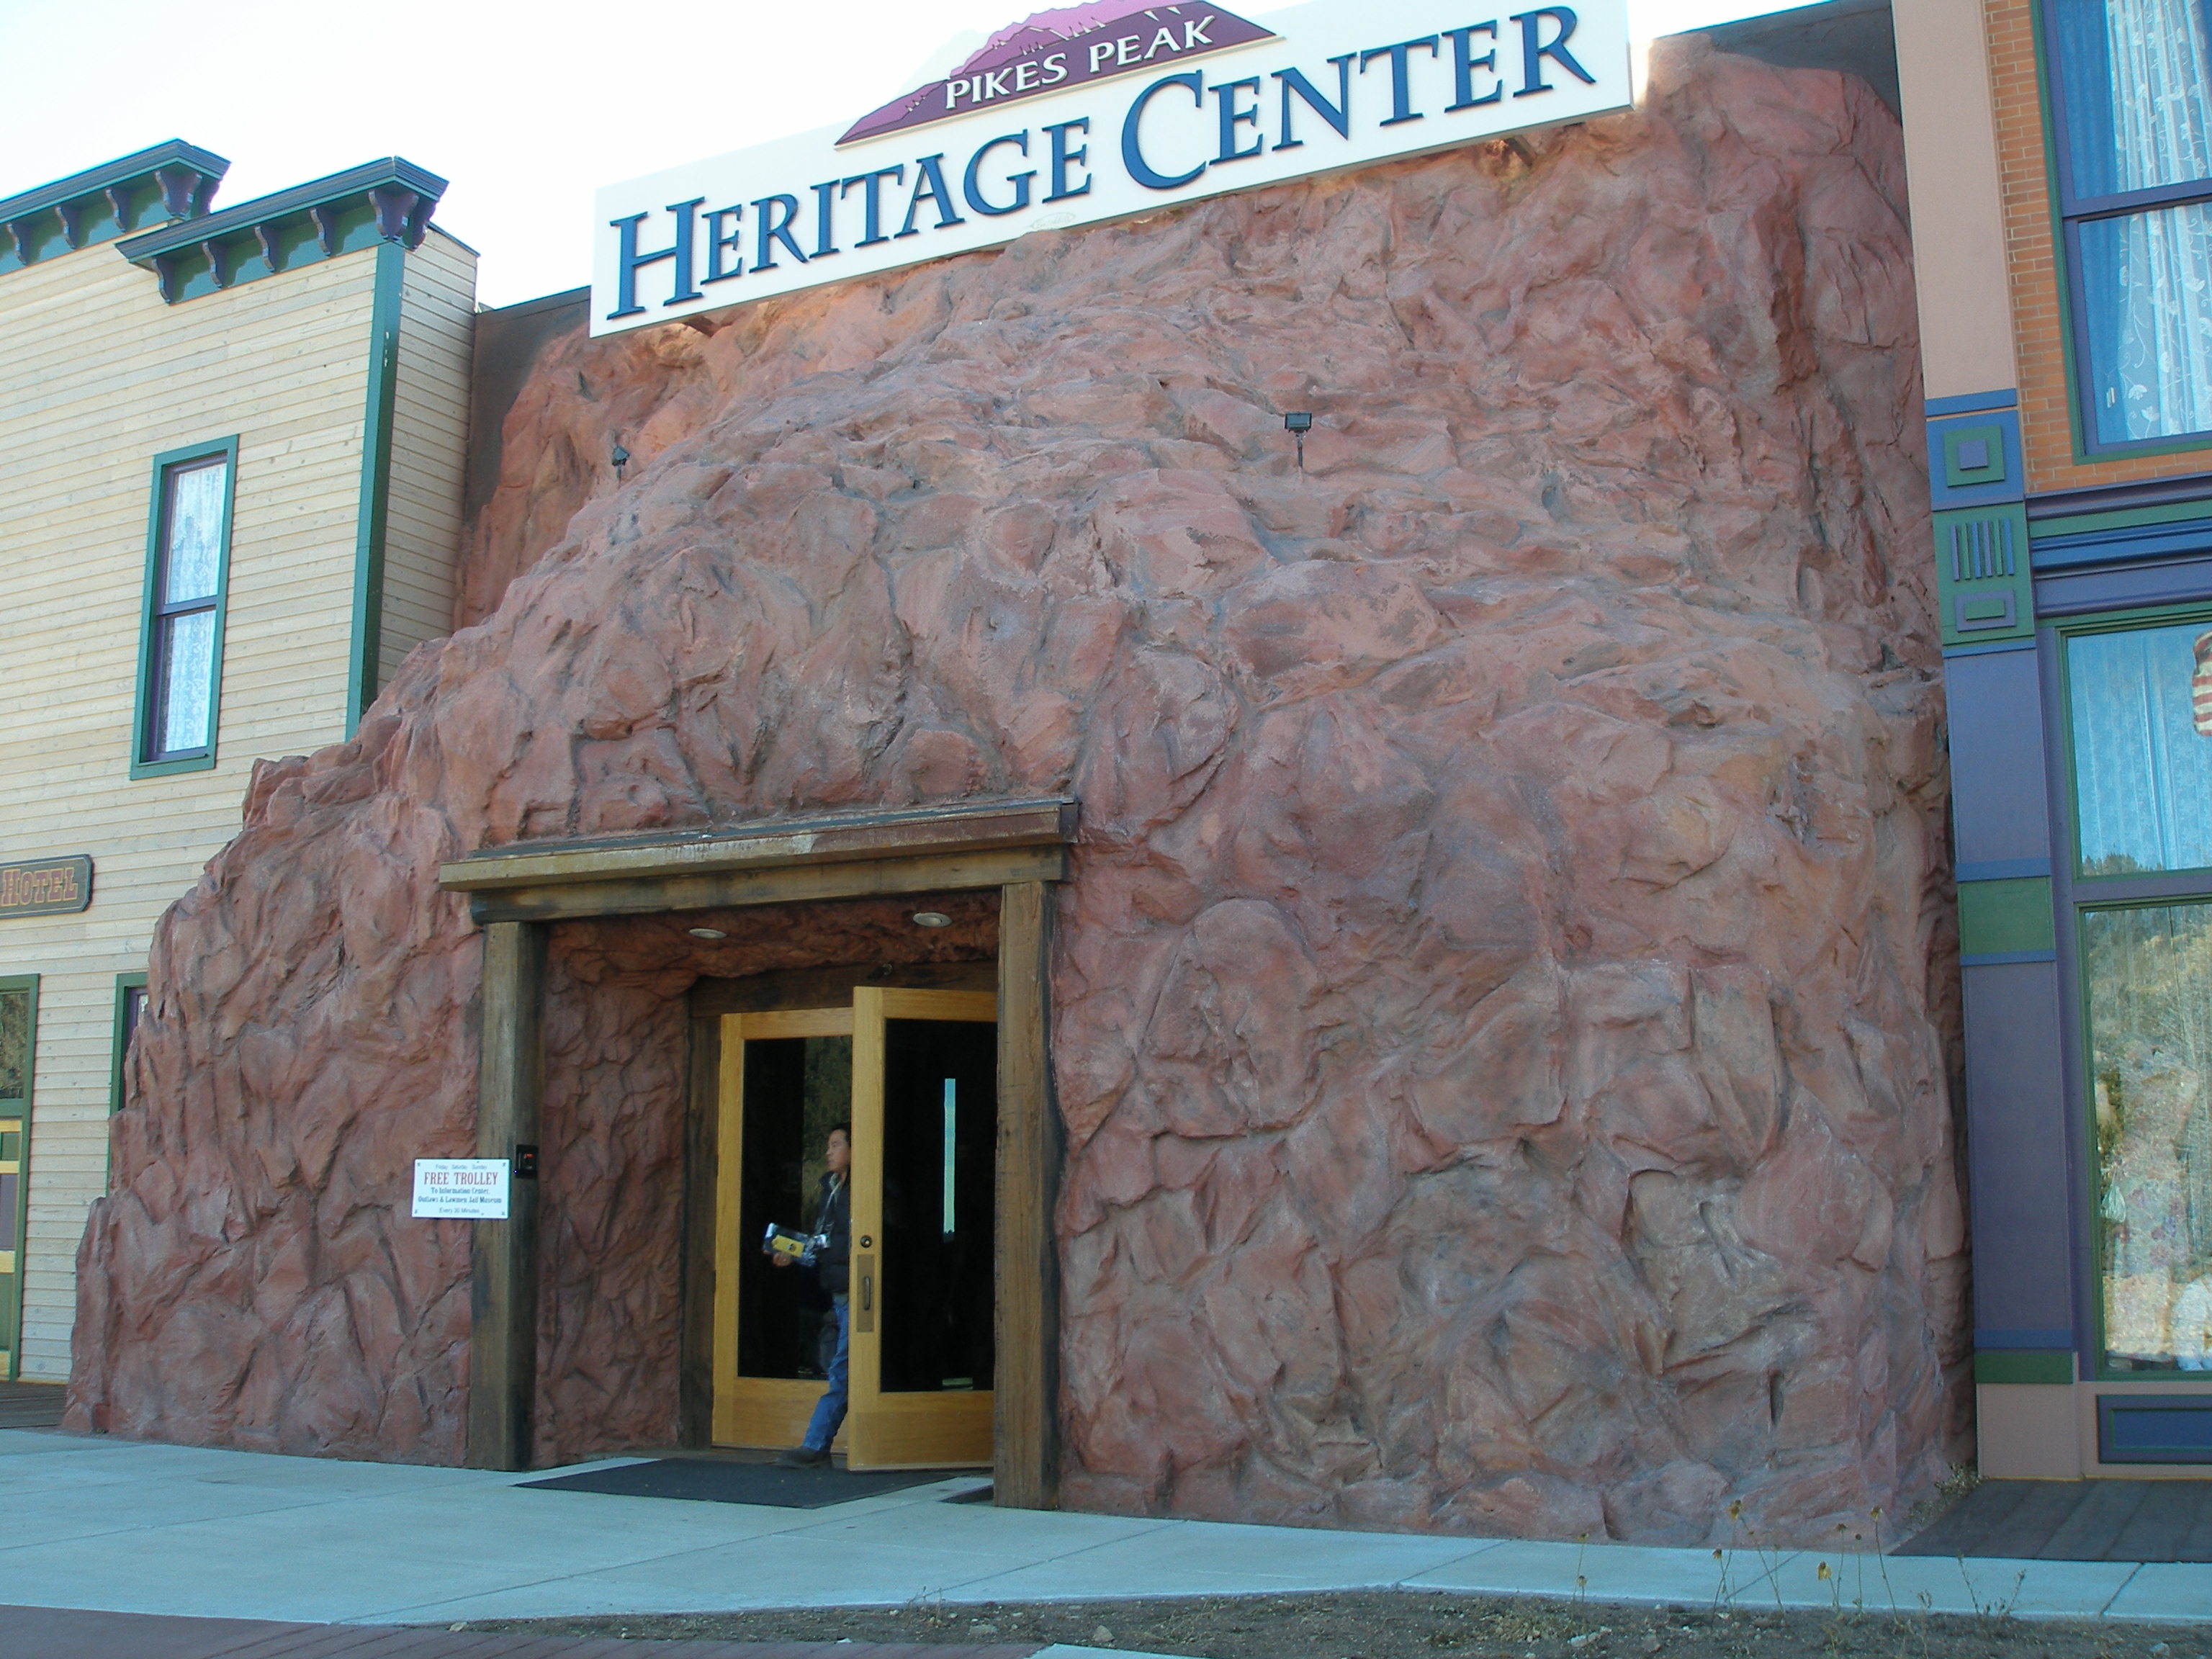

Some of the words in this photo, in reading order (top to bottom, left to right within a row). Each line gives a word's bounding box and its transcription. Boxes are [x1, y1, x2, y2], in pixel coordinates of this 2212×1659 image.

[945, 52, 1068, 110] PIKES
[1089, 14, 1215, 73] PEAK
[606, 116, 1092, 321] HERITAGE
[1121, 4, 1596, 190] CENTER
[1, 867, 78, 907] HOTEL
[424, 1172, 449, 1185] FREE
[454, 1172, 498, 1185] TROLLEY
